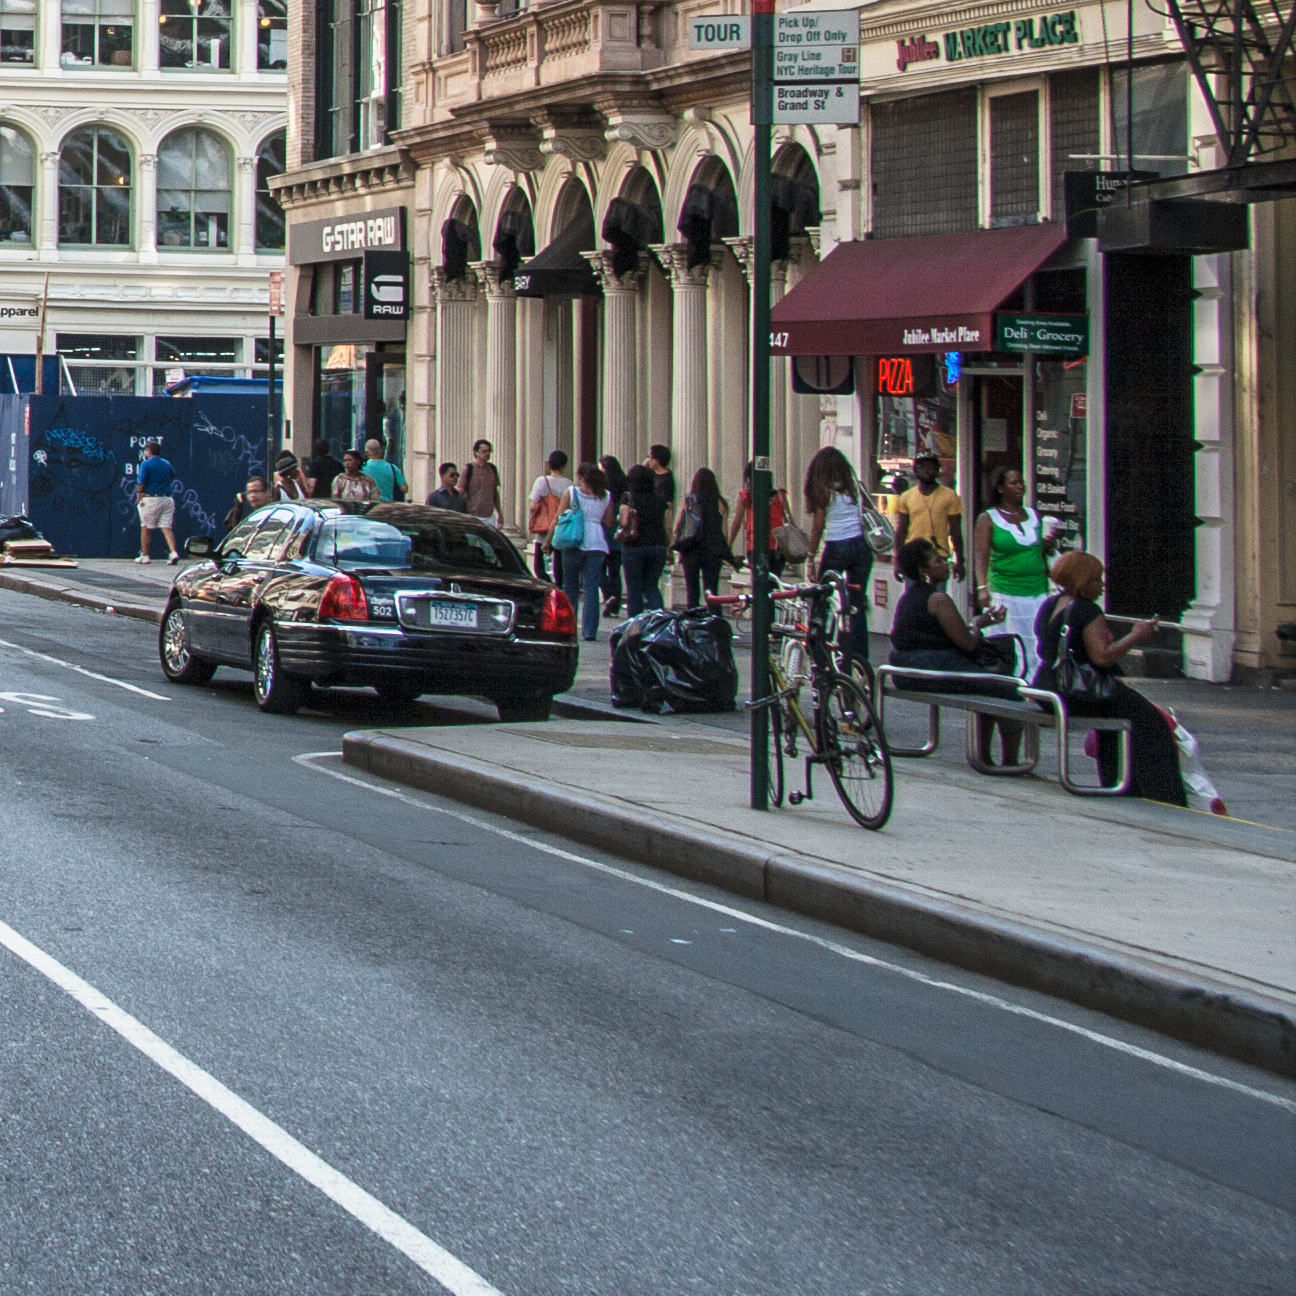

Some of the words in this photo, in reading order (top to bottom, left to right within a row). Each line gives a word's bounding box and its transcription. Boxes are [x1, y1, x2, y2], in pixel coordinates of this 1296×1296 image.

[778, 17, 799, 29] Pick
[694, 23, 741, 43] TOUR
[778, 31, 803, 45] Drop
[806, 30, 821, 43] Off
[824, 29, 848, 44] Only
[943, 20, 1012, 62] MARKET
[1015, 9, 1079, 51] PLACE
[776, 51, 799, 64] Gray
[801, 50, 822, 62] Line
[776, 65, 796, 77] NYC
[798, 64, 836, 77] Heritage
[838, 63, 857, 75] Tour
[777, 87, 830, 100] Broadway
[835, 86, 844, 98] &
[777, 99, 809, 111] Grand
[813, 98, 826, 111] St
[322, 220, 366, 253] G-STAR
[366, 215, 396, 247] RAW
[372, 304, 404, 315] RAW
[902, 329, 930, 345] Jubilee
[930, 328, 958, 344] Market
[957, 326, 980, 343] Place
[1004, 327, 1028, 339] Deli
[1036, 328, 1084, 345] Grocery
[878, 357, 913, 394] PIZZA
[130, 435, 164, 448] POST
[373, 605, 392, 616] 502
